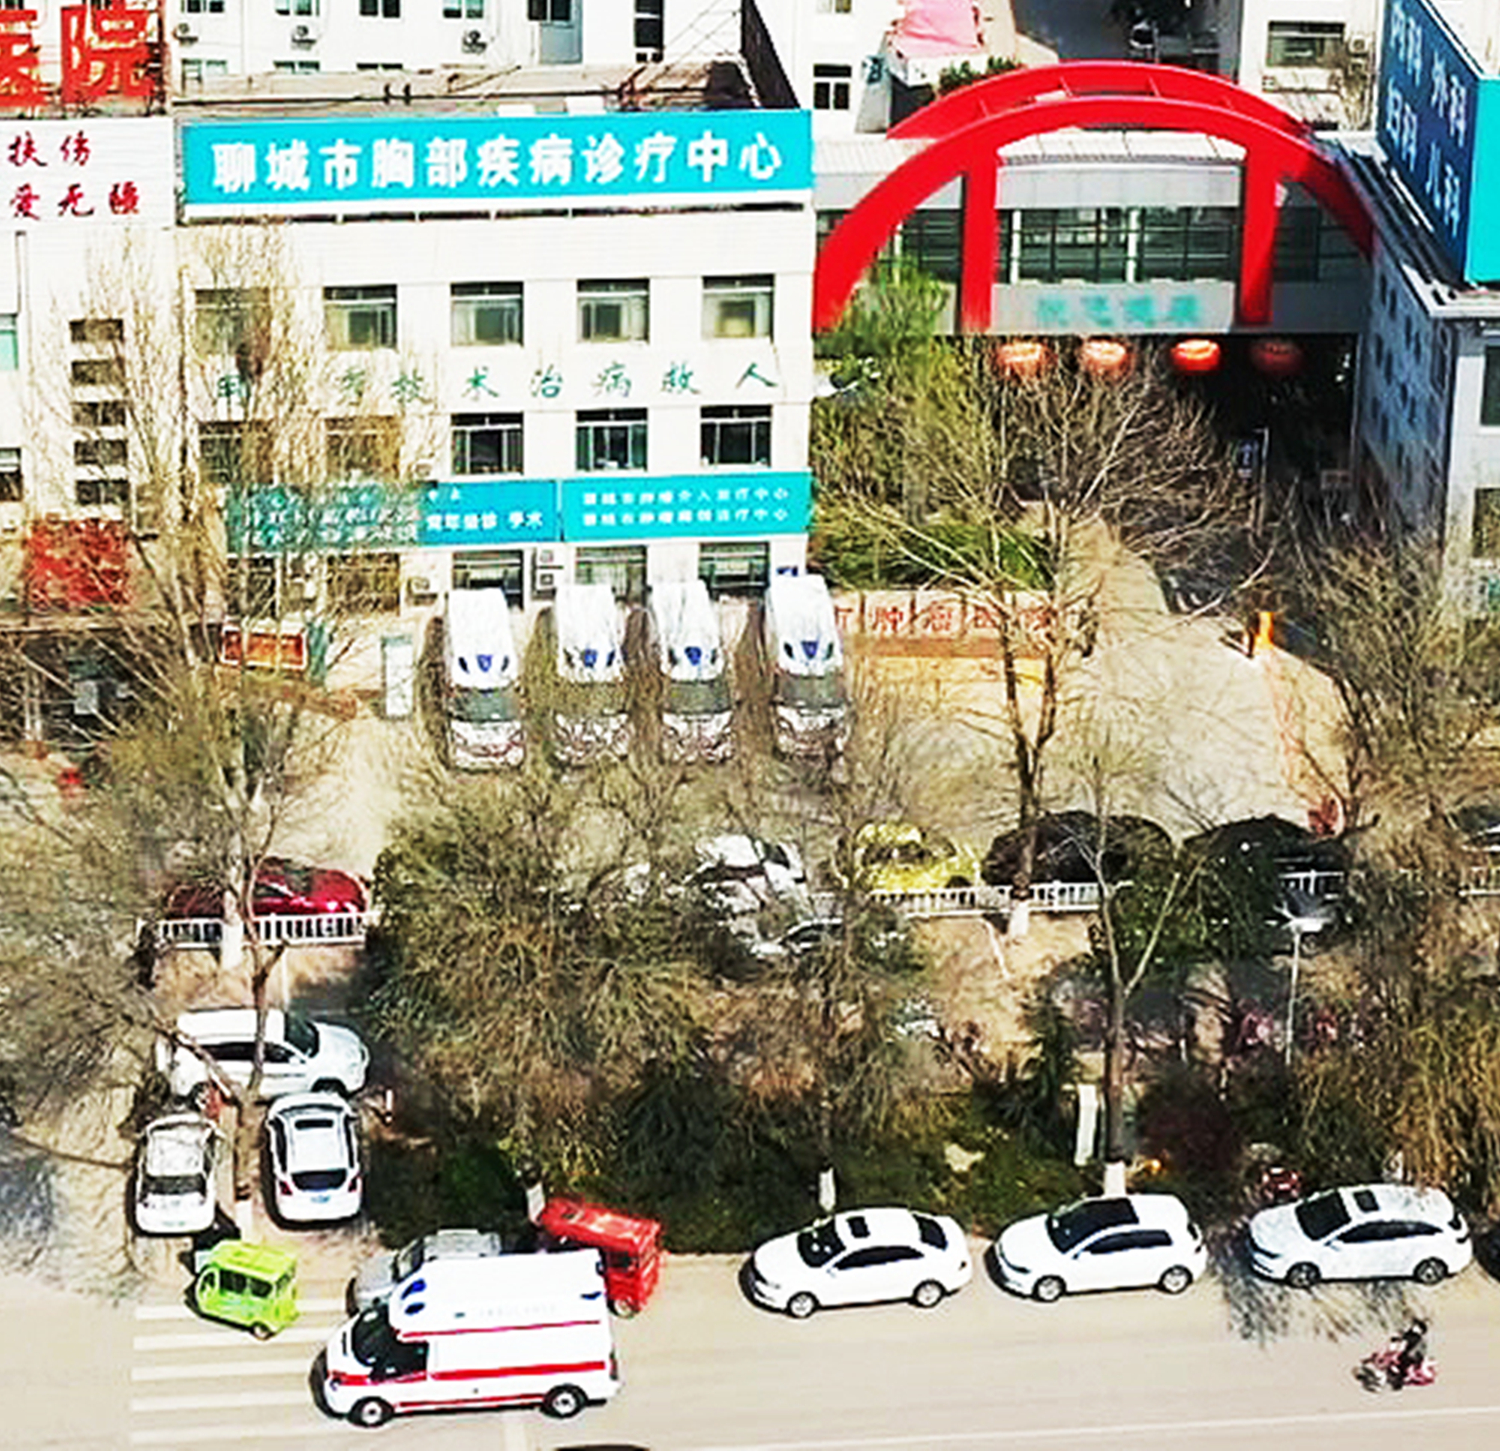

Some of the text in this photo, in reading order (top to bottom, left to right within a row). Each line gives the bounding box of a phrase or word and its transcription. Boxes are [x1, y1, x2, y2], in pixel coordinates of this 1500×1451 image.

[211, 132, 784, 193] 聊城市胸部疾病诊疗中心
